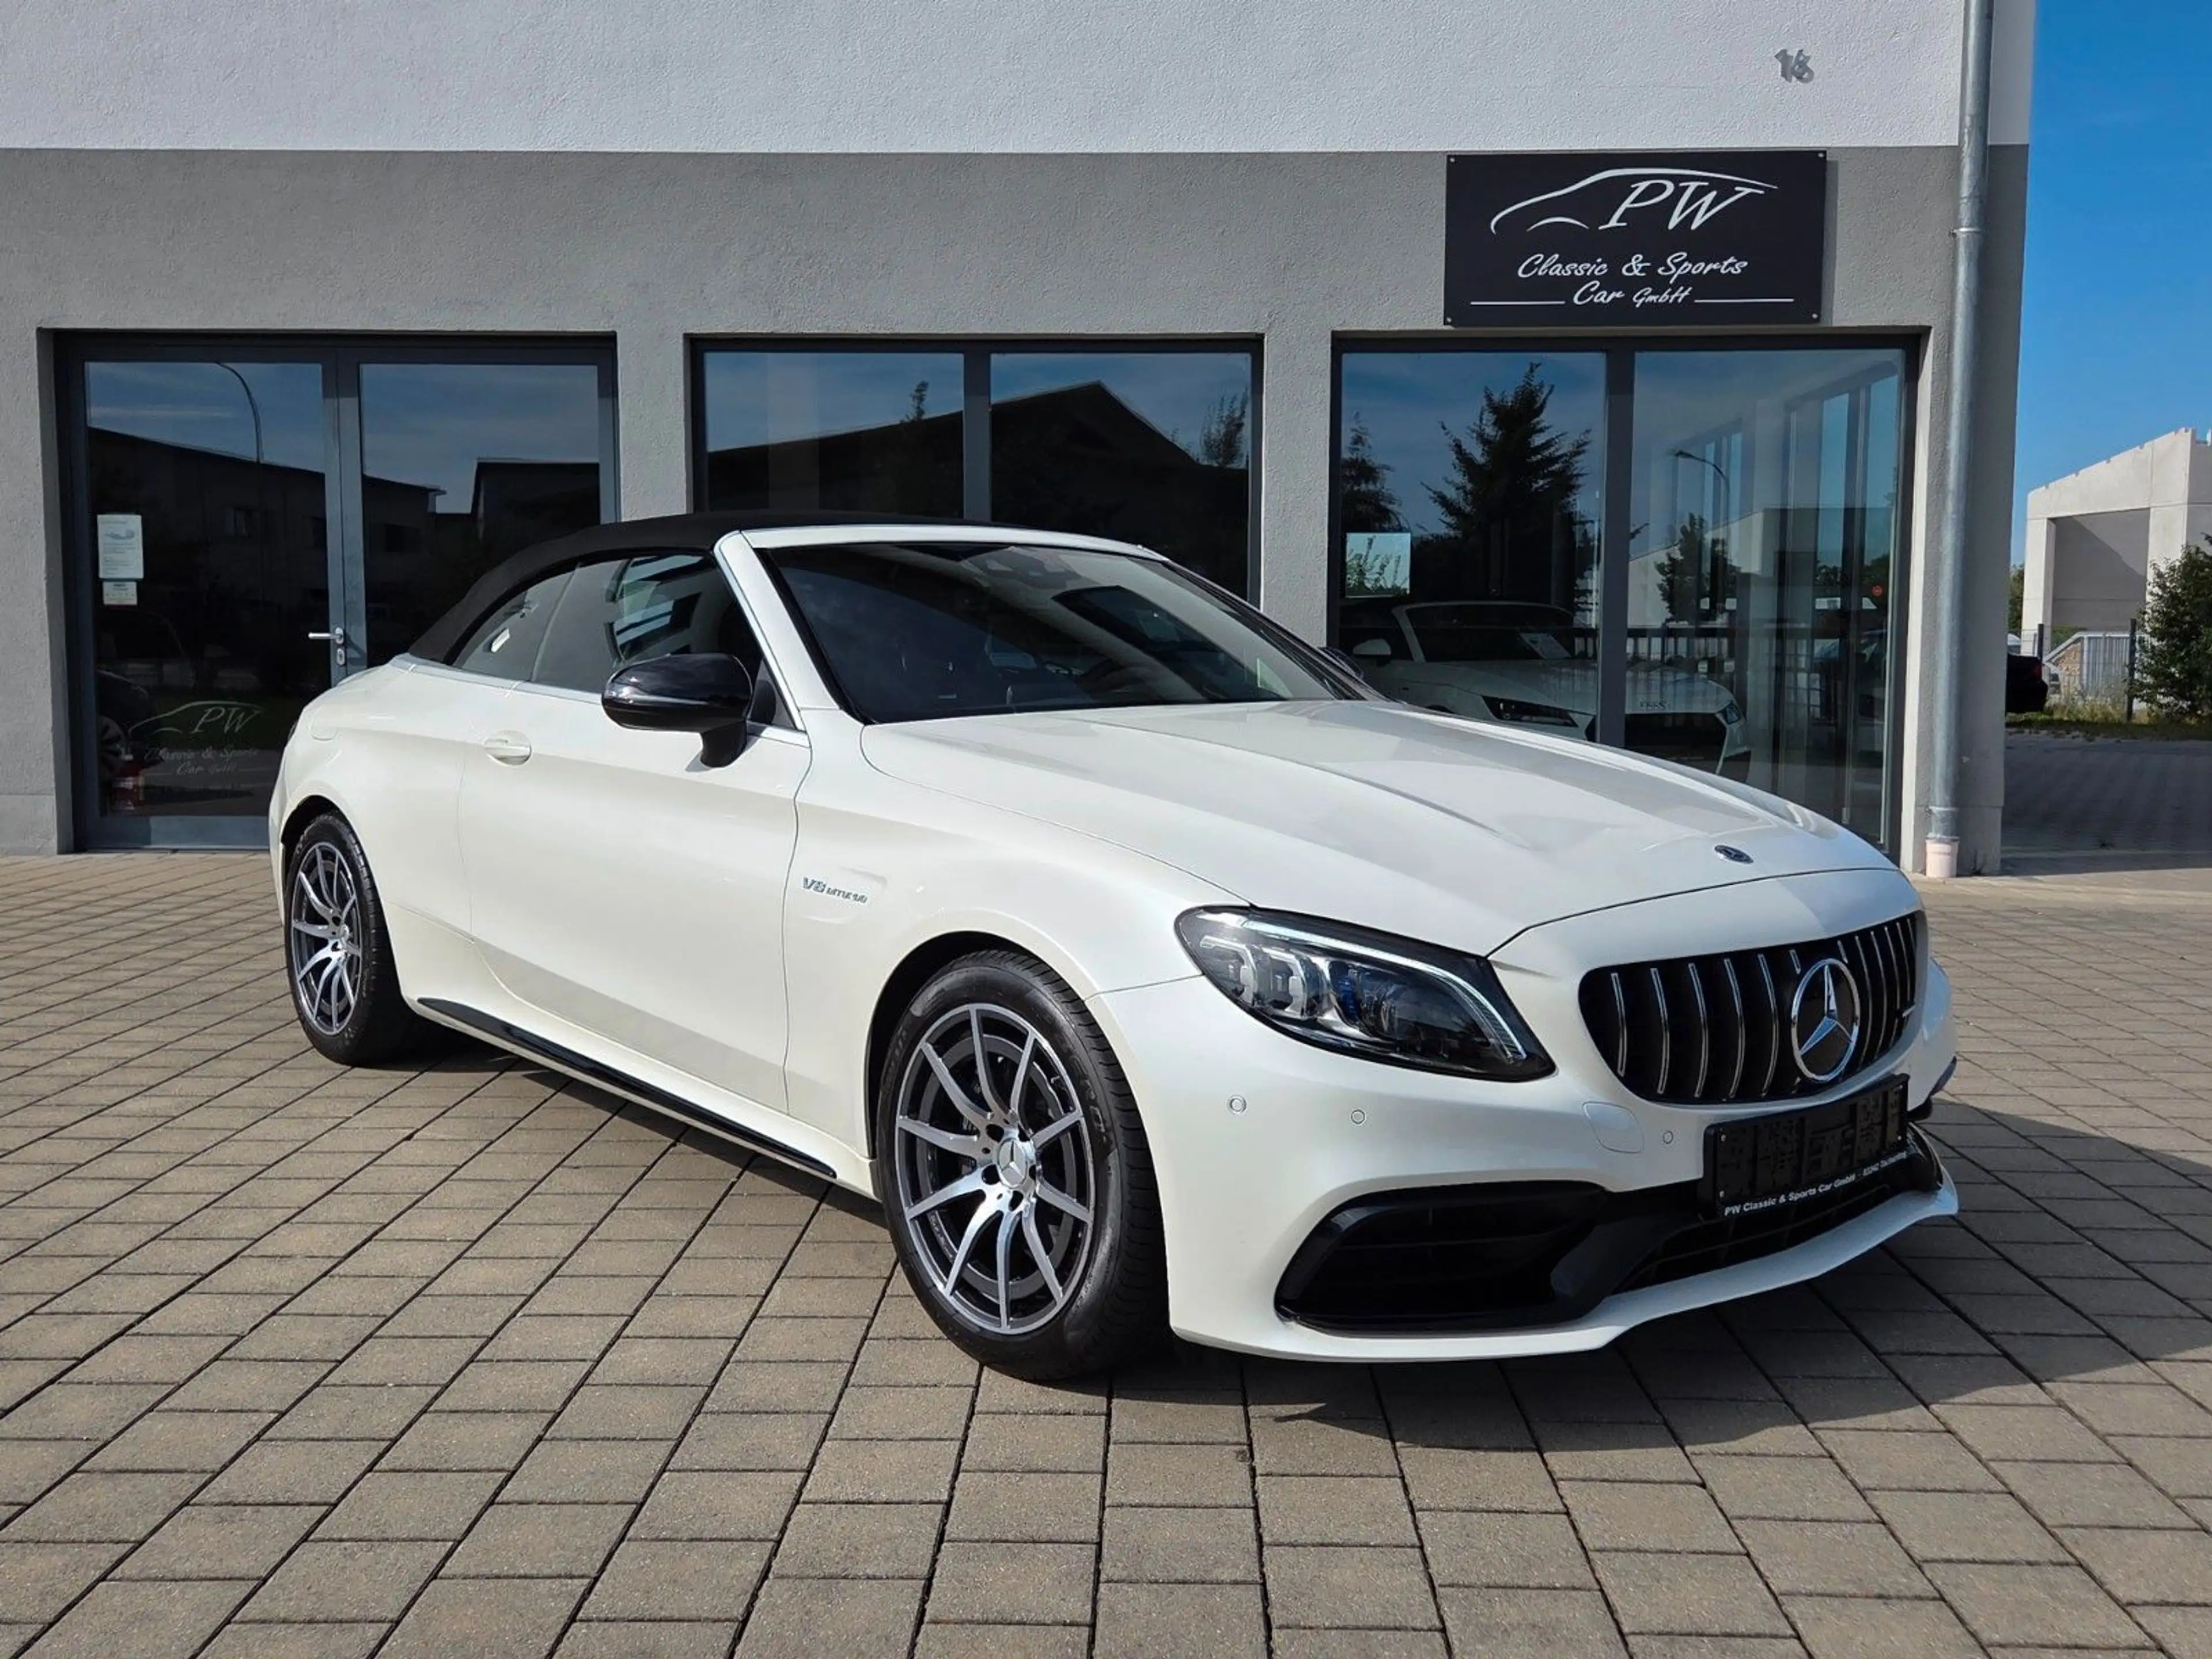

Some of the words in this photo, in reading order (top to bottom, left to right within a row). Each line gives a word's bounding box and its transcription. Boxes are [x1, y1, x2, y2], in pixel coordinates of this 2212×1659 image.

[1599, 179, 1764, 230] PW
[1518, 253, 1608, 278] Classic
[1622, 254, 1652, 276] &
[1657, 252, 1748, 284] Sports
[1573, 281, 1625, 305] Car
[1633, 286, 1693, 308] GmbH
[190, 706, 262, 734] PW
[803, 877, 827, 893] V8
[1725, 1205, 1741, 1216] PW
[1744, 1198, 1776, 1211] Classic
[1779, 1195, 1786, 1203] &
[1789, 1188, 1816, 1202] Sports
[1818, 1183, 1832, 1193] Car
